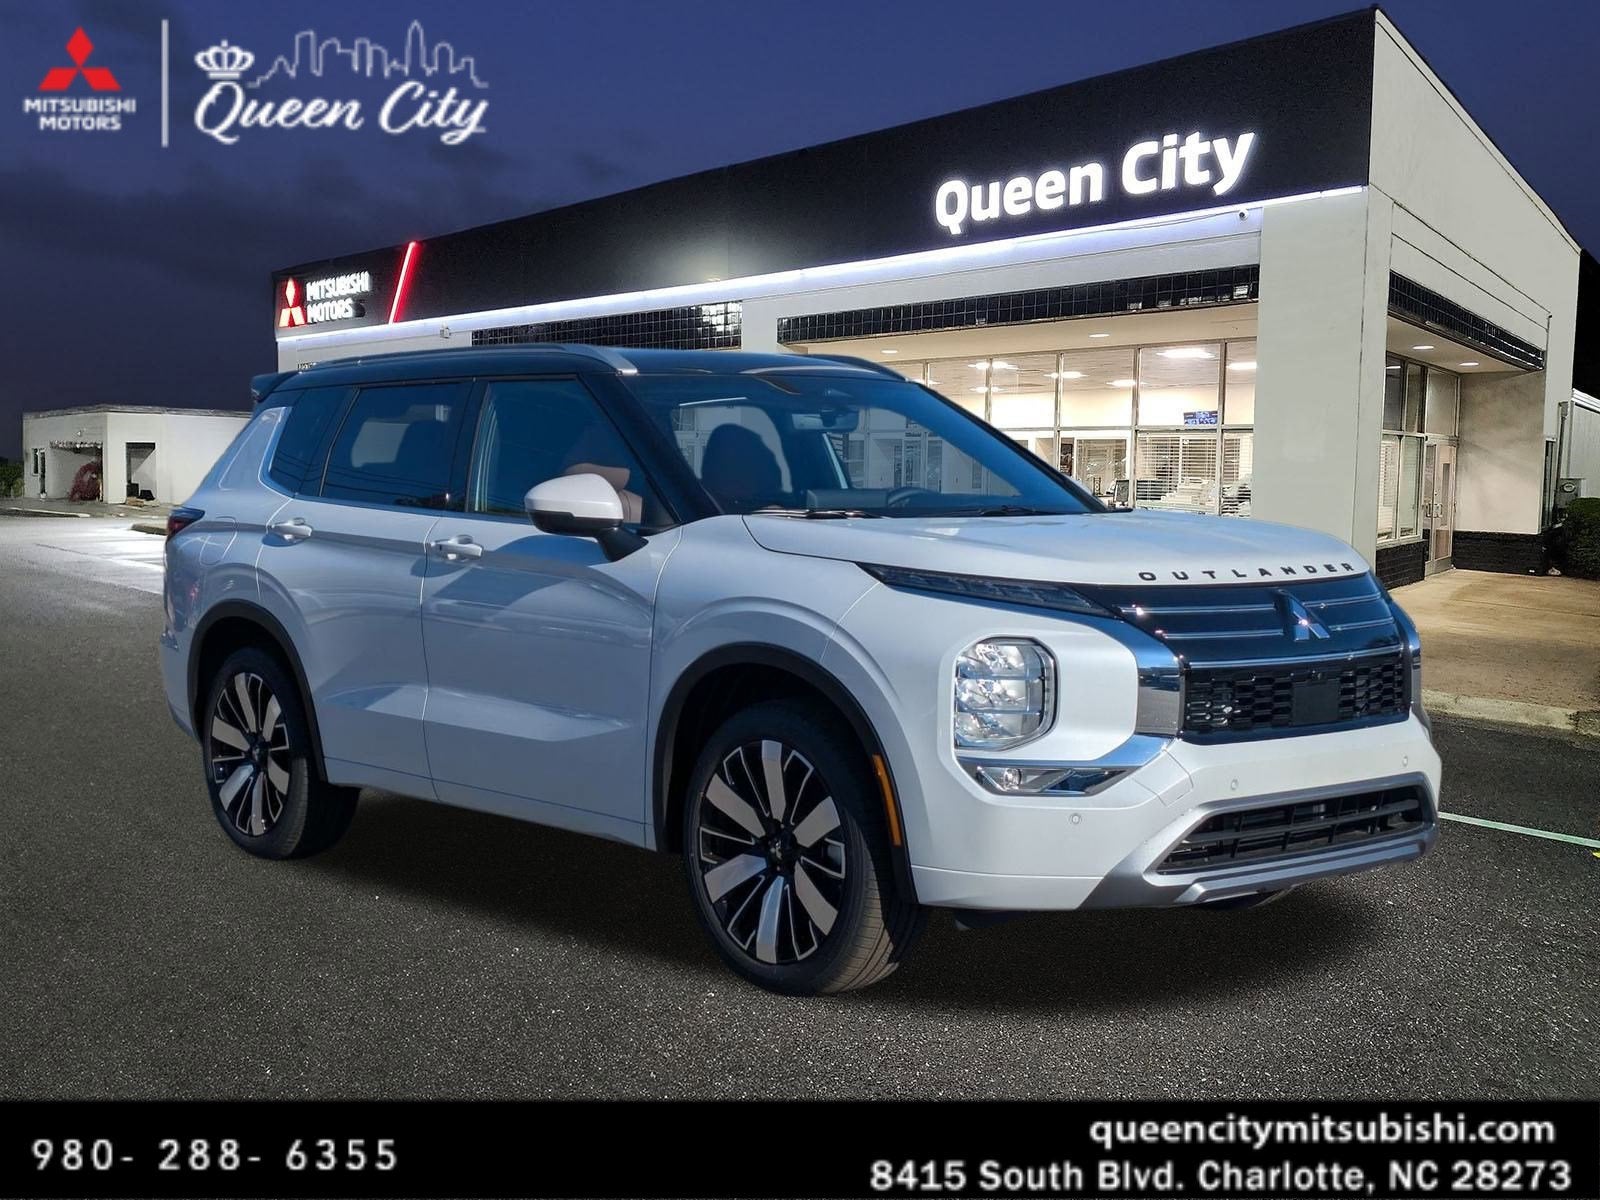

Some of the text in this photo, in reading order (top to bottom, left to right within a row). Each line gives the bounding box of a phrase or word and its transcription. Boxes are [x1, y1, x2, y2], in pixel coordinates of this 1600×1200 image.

[935, 131, 1256, 235] Queen City
[306, 271, 371, 302] MITSUBISHI
[306, 298, 355, 324] MOTORS
[1138, 562, 1355, 582] OUTLANDER
